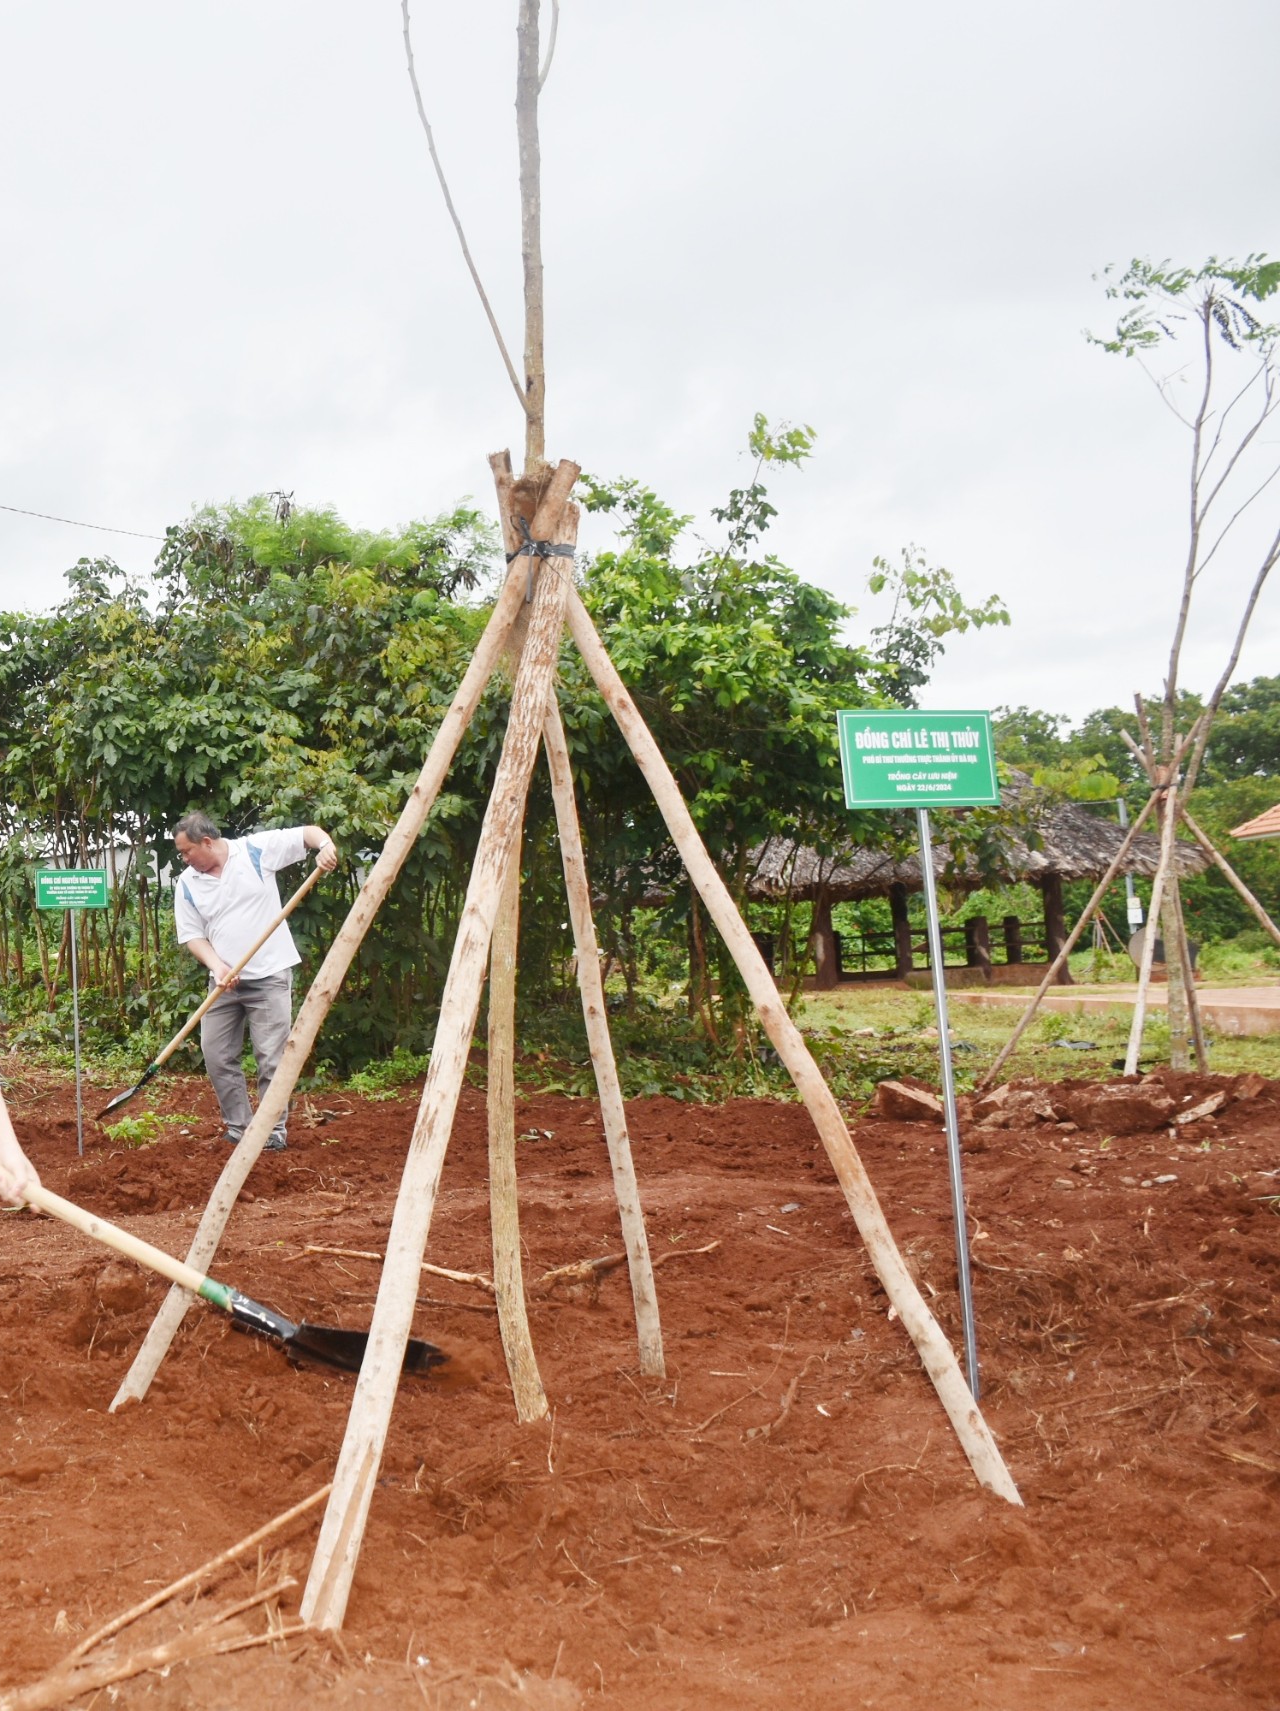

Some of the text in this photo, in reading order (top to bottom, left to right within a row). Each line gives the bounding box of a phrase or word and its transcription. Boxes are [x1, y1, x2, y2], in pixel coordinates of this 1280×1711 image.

[855, 726, 979, 752] ĐỒNG CHÍ LÊ THỊ THỦY
[912, 771, 927, 780] CÂY
[896, 783, 952, 792] NGÀY 22/6/2024
